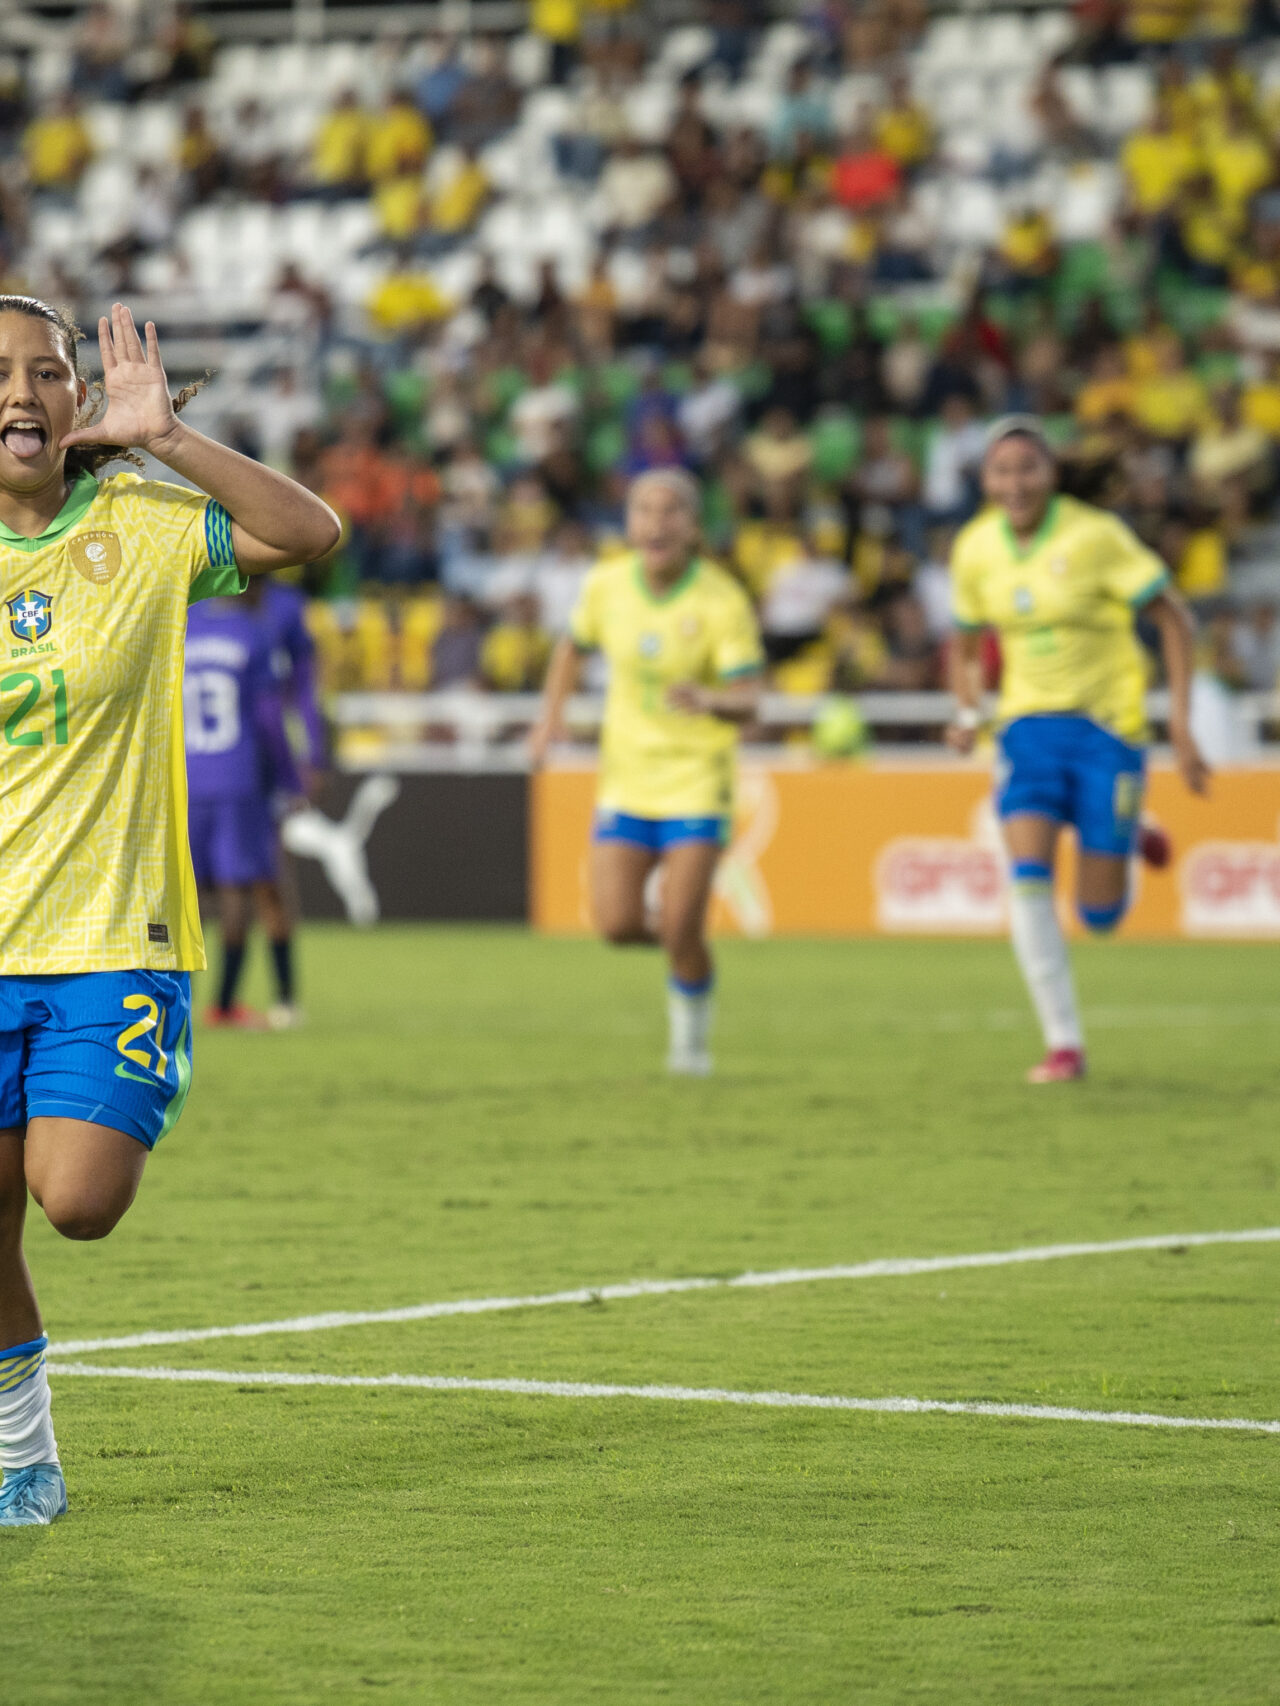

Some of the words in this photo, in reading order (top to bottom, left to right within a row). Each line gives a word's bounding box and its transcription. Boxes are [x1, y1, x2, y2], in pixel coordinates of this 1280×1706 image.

[22, 609, 40, 619] CBF
[11, 642, 57, 658] BRASIL
[0, 669, 68, 746] 21
[117, 994, 168, 1079] 21
